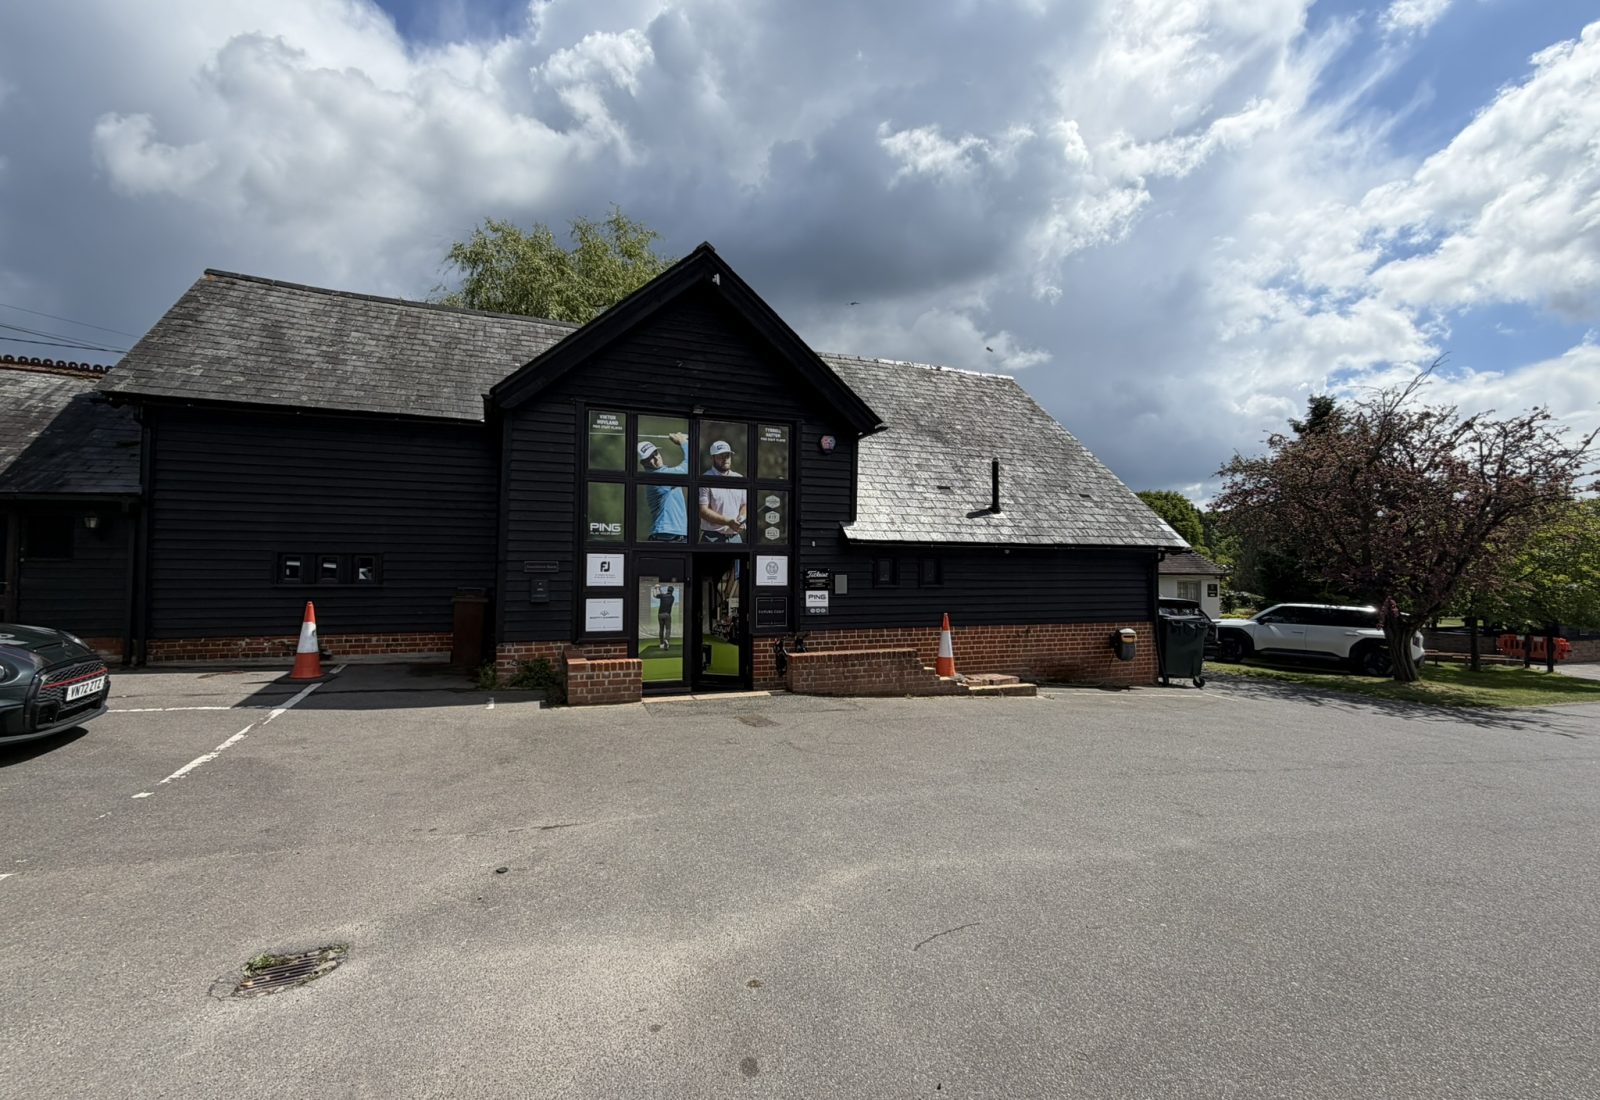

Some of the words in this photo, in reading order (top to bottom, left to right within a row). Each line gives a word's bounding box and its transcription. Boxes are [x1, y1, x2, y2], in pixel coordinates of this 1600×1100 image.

[590, 522, 621, 532] PING
[600, 561, 610, 572] FJ
[71, 683, 89, 697] VN72
[89, 678, 102, 692] ZTZ
